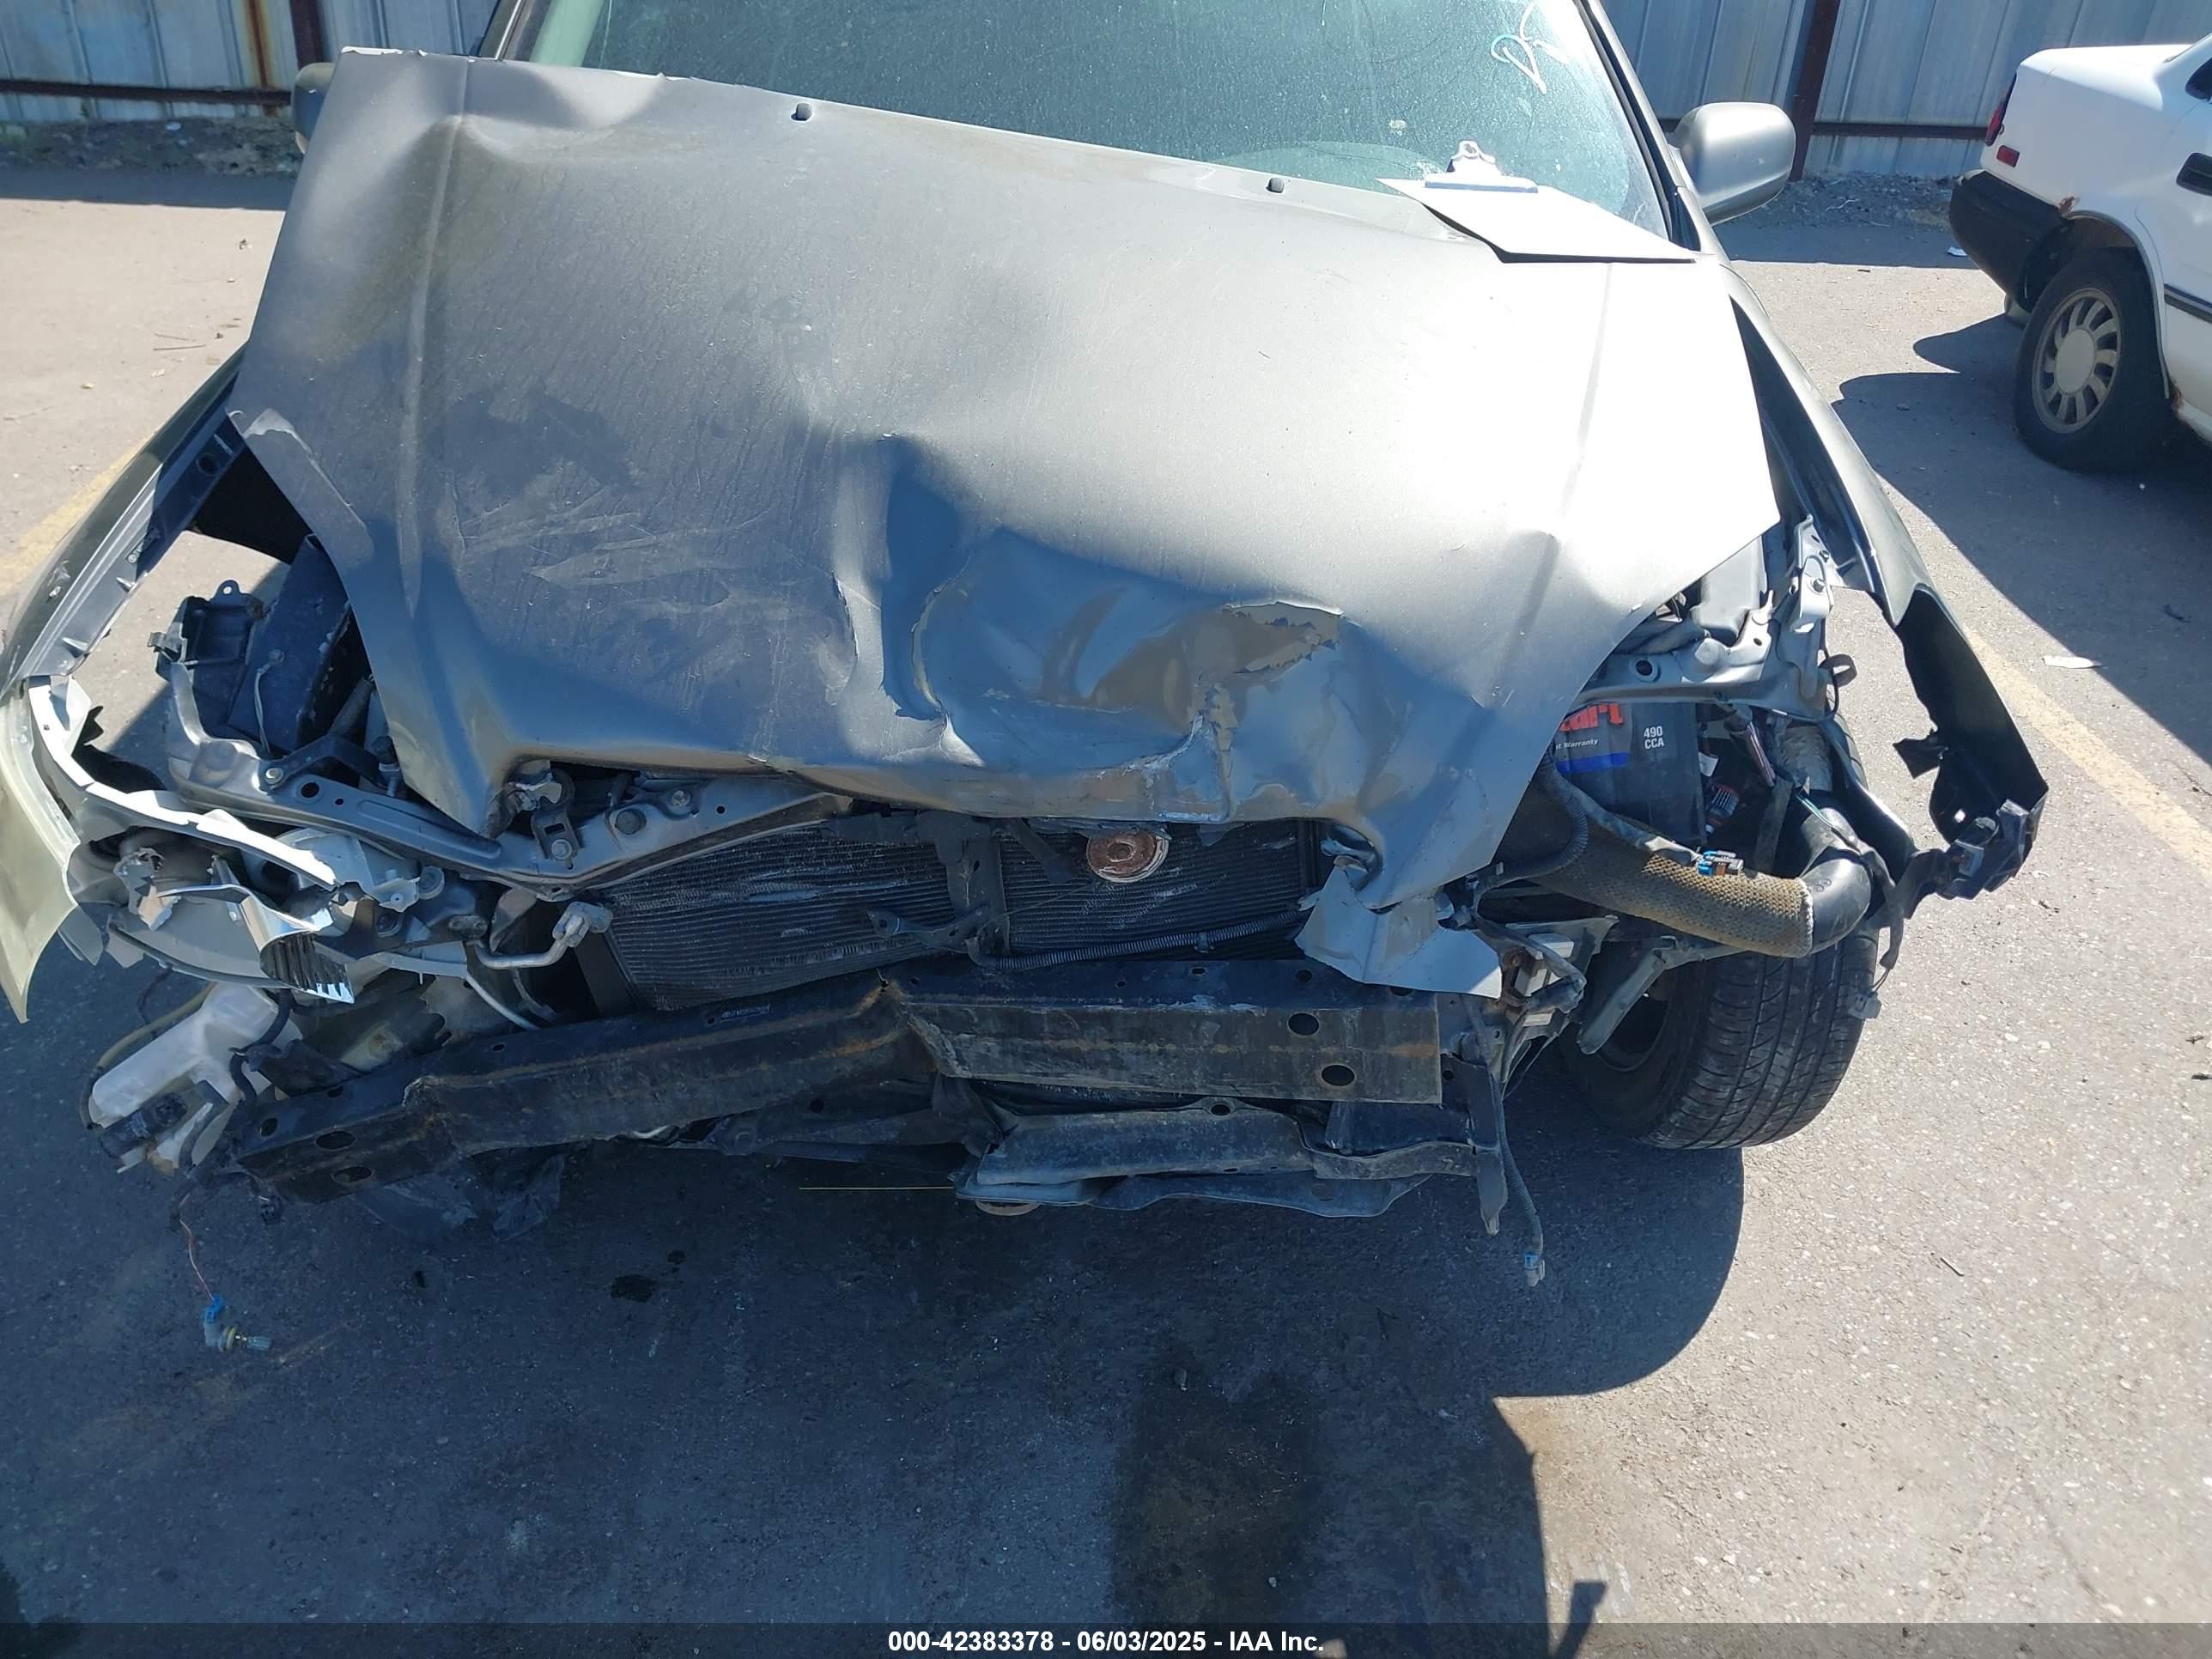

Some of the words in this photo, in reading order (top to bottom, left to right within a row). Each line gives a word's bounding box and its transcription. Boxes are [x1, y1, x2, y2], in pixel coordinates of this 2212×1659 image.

[1644, 726, 1663, 738] 490
[1564, 738, 1600, 748] Warranty
[1644, 738, 1664, 750] CCA
